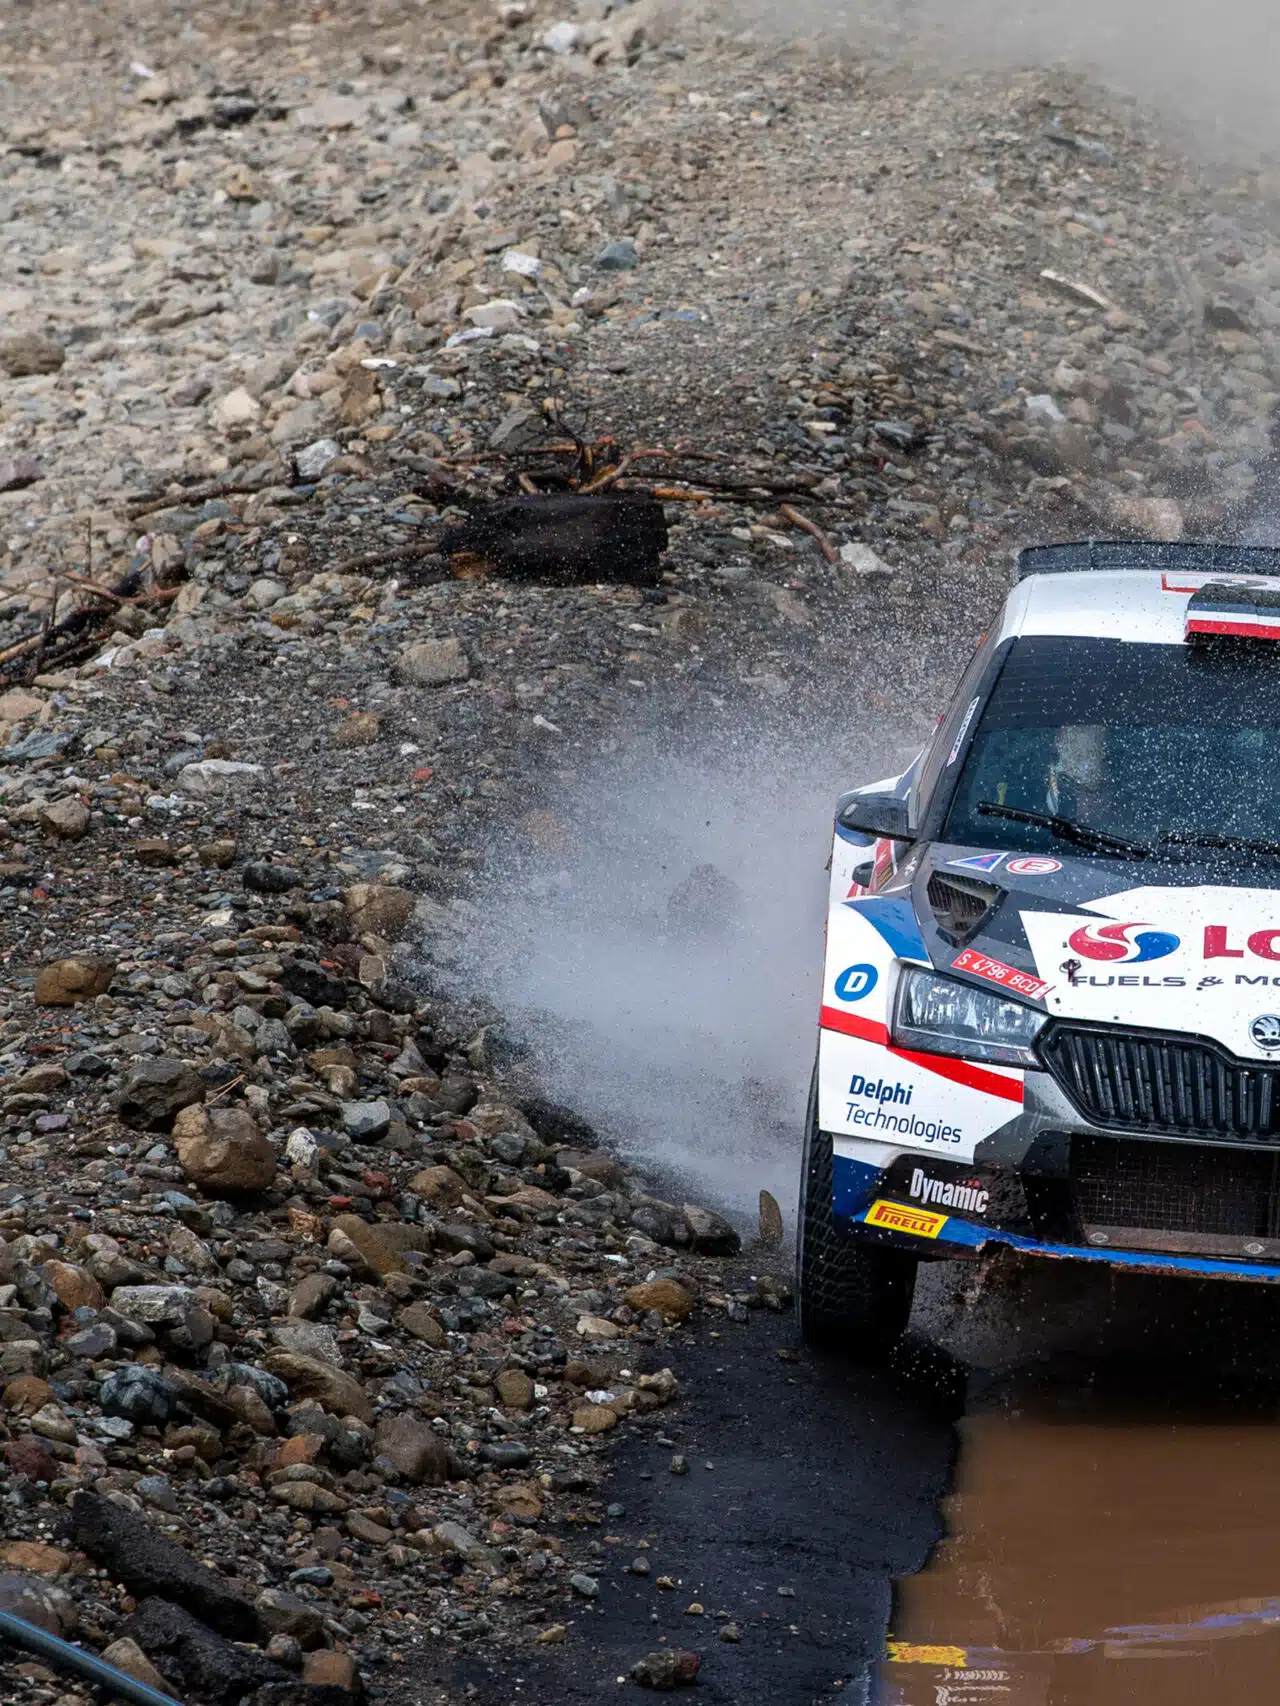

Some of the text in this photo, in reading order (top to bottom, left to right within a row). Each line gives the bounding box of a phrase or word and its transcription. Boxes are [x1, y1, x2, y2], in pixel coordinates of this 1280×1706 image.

[843, 971, 869, 993] D
[958, 953, 1040, 992] S 4796 BCD
[1071, 975, 1187, 987] FUELS
[1198, 975, 1224, 987] &
[848, 1074, 914, 1105] Delphi
[845, 1101, 963, 1143] Technologies
[909, 1168, 990, 1213] Dynamic
[873, 1204, 940, 1234] PIRELLI
